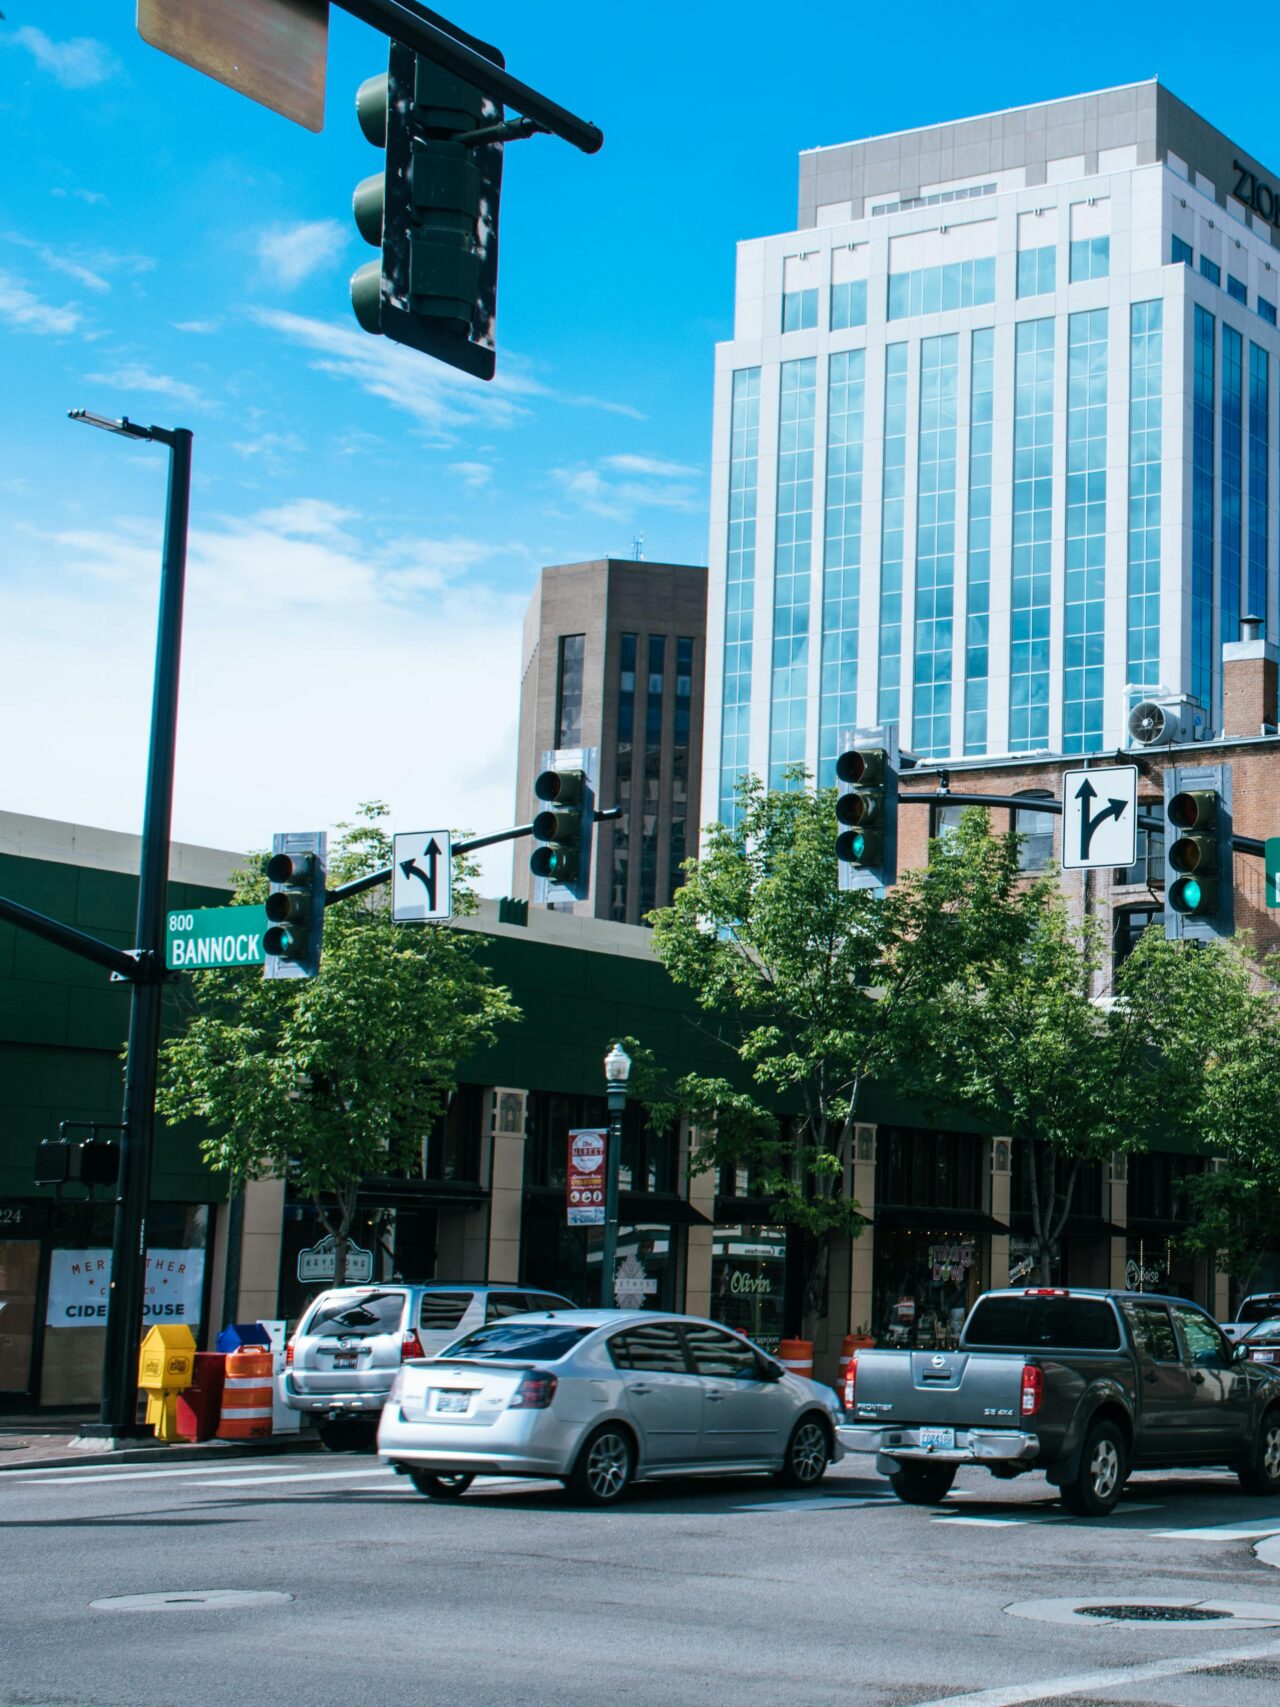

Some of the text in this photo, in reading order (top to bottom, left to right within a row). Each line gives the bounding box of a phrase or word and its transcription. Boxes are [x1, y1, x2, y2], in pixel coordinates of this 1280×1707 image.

[170, 915, 193, 931] 800
[172, 934, 260, 965] BANNOCK
[573, 1148, 603, 1156] MARKET
[0, 1209, 23, 1223] 24
[72, 1258, 187, 1275] MERTHER
[306, 1259, 366, 1268] KEYSONE
[730, 1270, 771, 1294] Olivin
[65, 1303, 185, 1318] CIDE OUSE
[856, 1403, 894, 1411] FRONTIER
